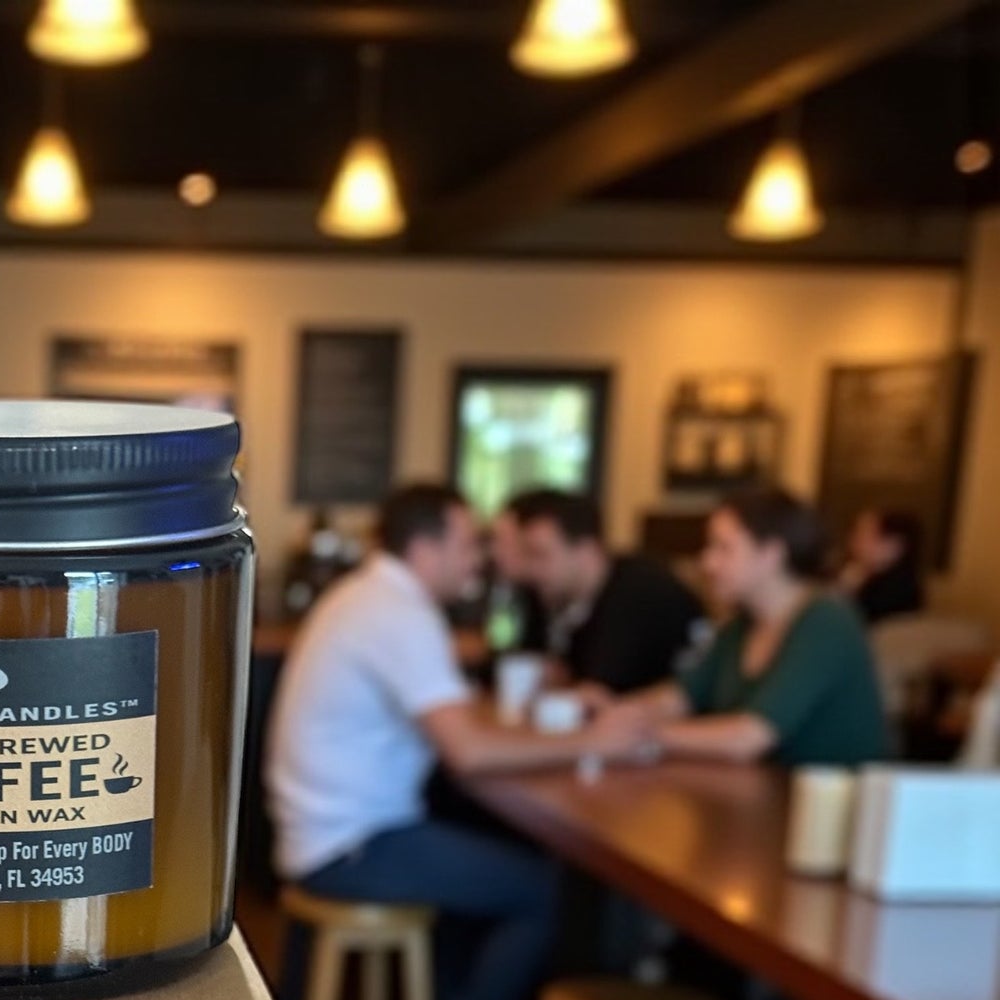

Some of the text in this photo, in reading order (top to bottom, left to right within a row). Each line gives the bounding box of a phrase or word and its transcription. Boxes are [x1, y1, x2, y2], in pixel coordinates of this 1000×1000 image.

[27, 806, 86, 823] WAX
[13, 841, 39, 860] For
[43, 839, 87, 863] Every
[92, 832, 134, 854] BODY
[7, 870, 25, 889] FL
[30, 866, 84, 887] 34953
